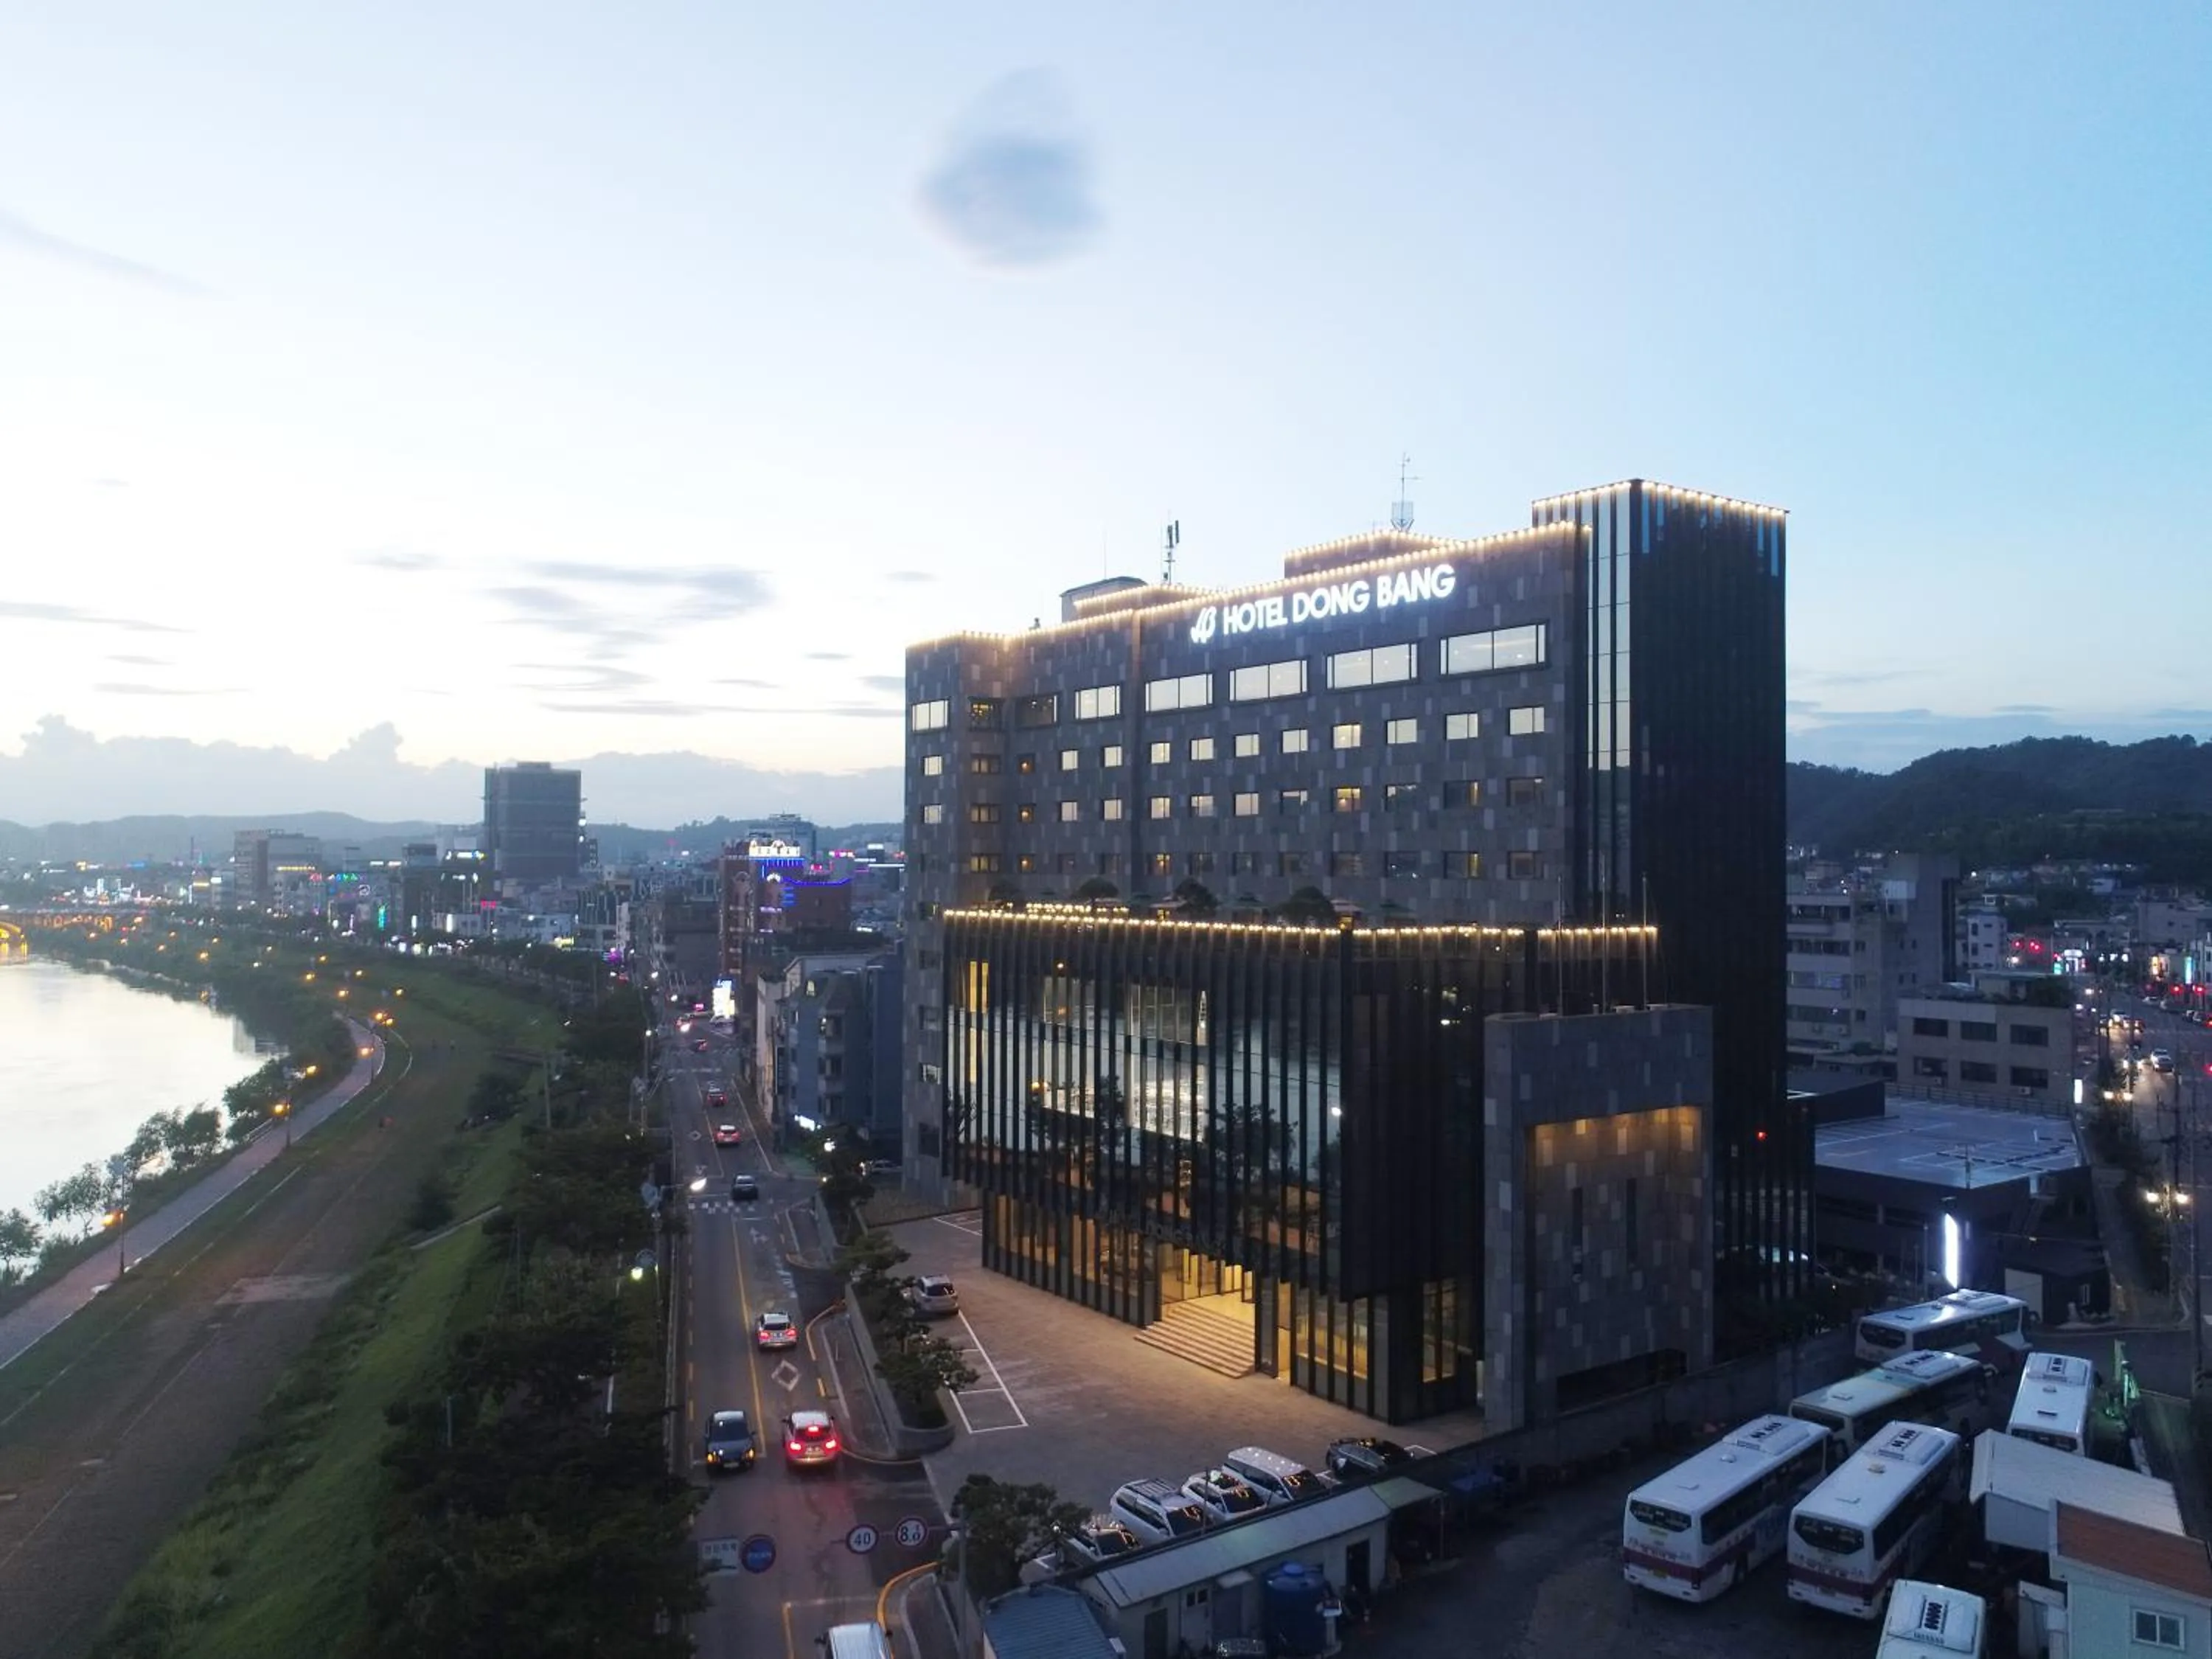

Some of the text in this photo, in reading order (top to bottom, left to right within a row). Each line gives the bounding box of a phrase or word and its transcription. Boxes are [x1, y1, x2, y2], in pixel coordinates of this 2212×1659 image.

[1222, 563, 1455, 635] HOTEL DONG BANG
[853, 1531, 872, 1546] 40
